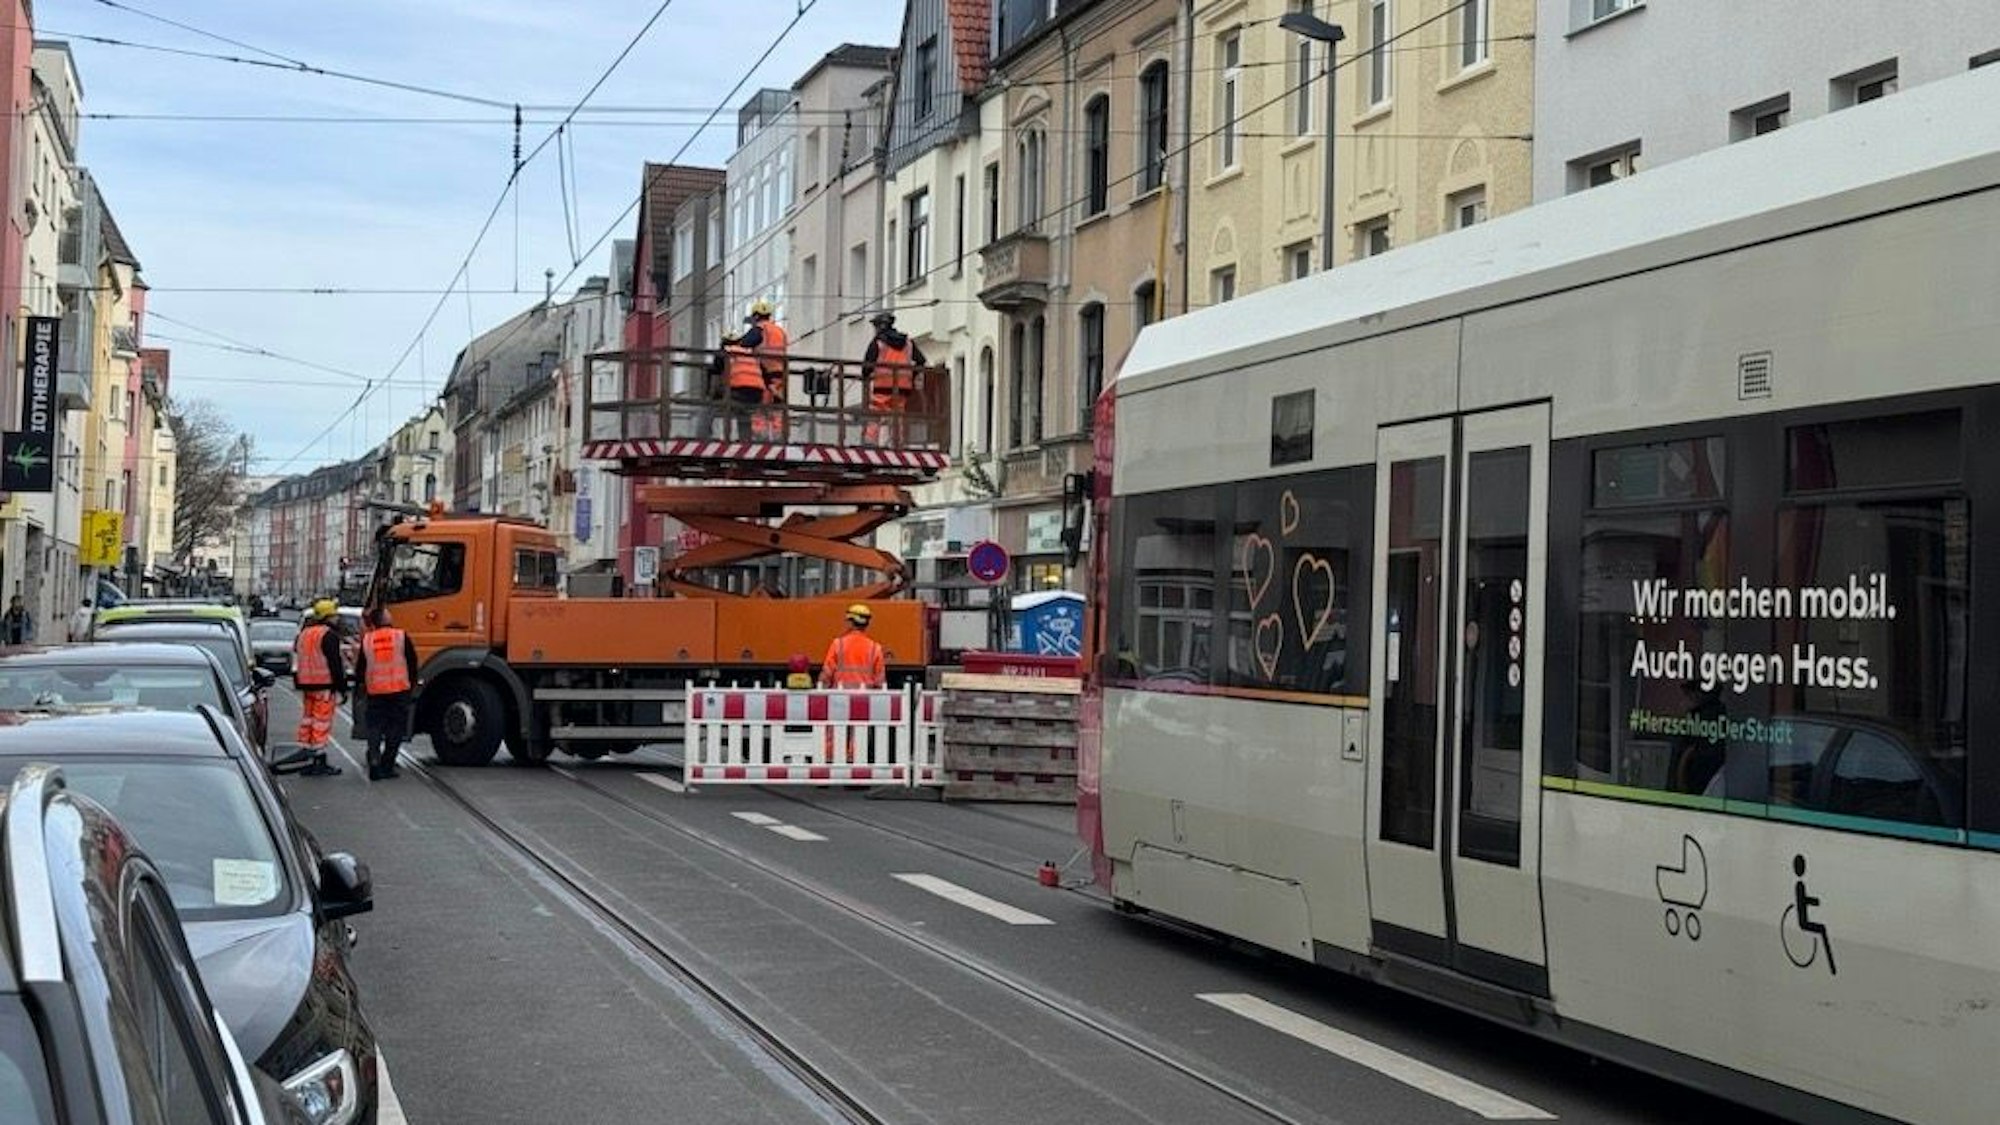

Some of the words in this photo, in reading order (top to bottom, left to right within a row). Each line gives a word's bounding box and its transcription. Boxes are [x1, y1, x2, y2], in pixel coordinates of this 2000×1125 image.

[1632, 578, 1679, 618] Wir
[1684, 576, 1791, 618] machen
[1801, 573, 1896, 619] mobil.
[1630, 640, 1693, 680] Auch
[1700, 652, 1783, 693] gegen
[1792, 644, 1878, 689] Hass.
[1629, 709, 1795, 744] #HerzschlagDerStadt
